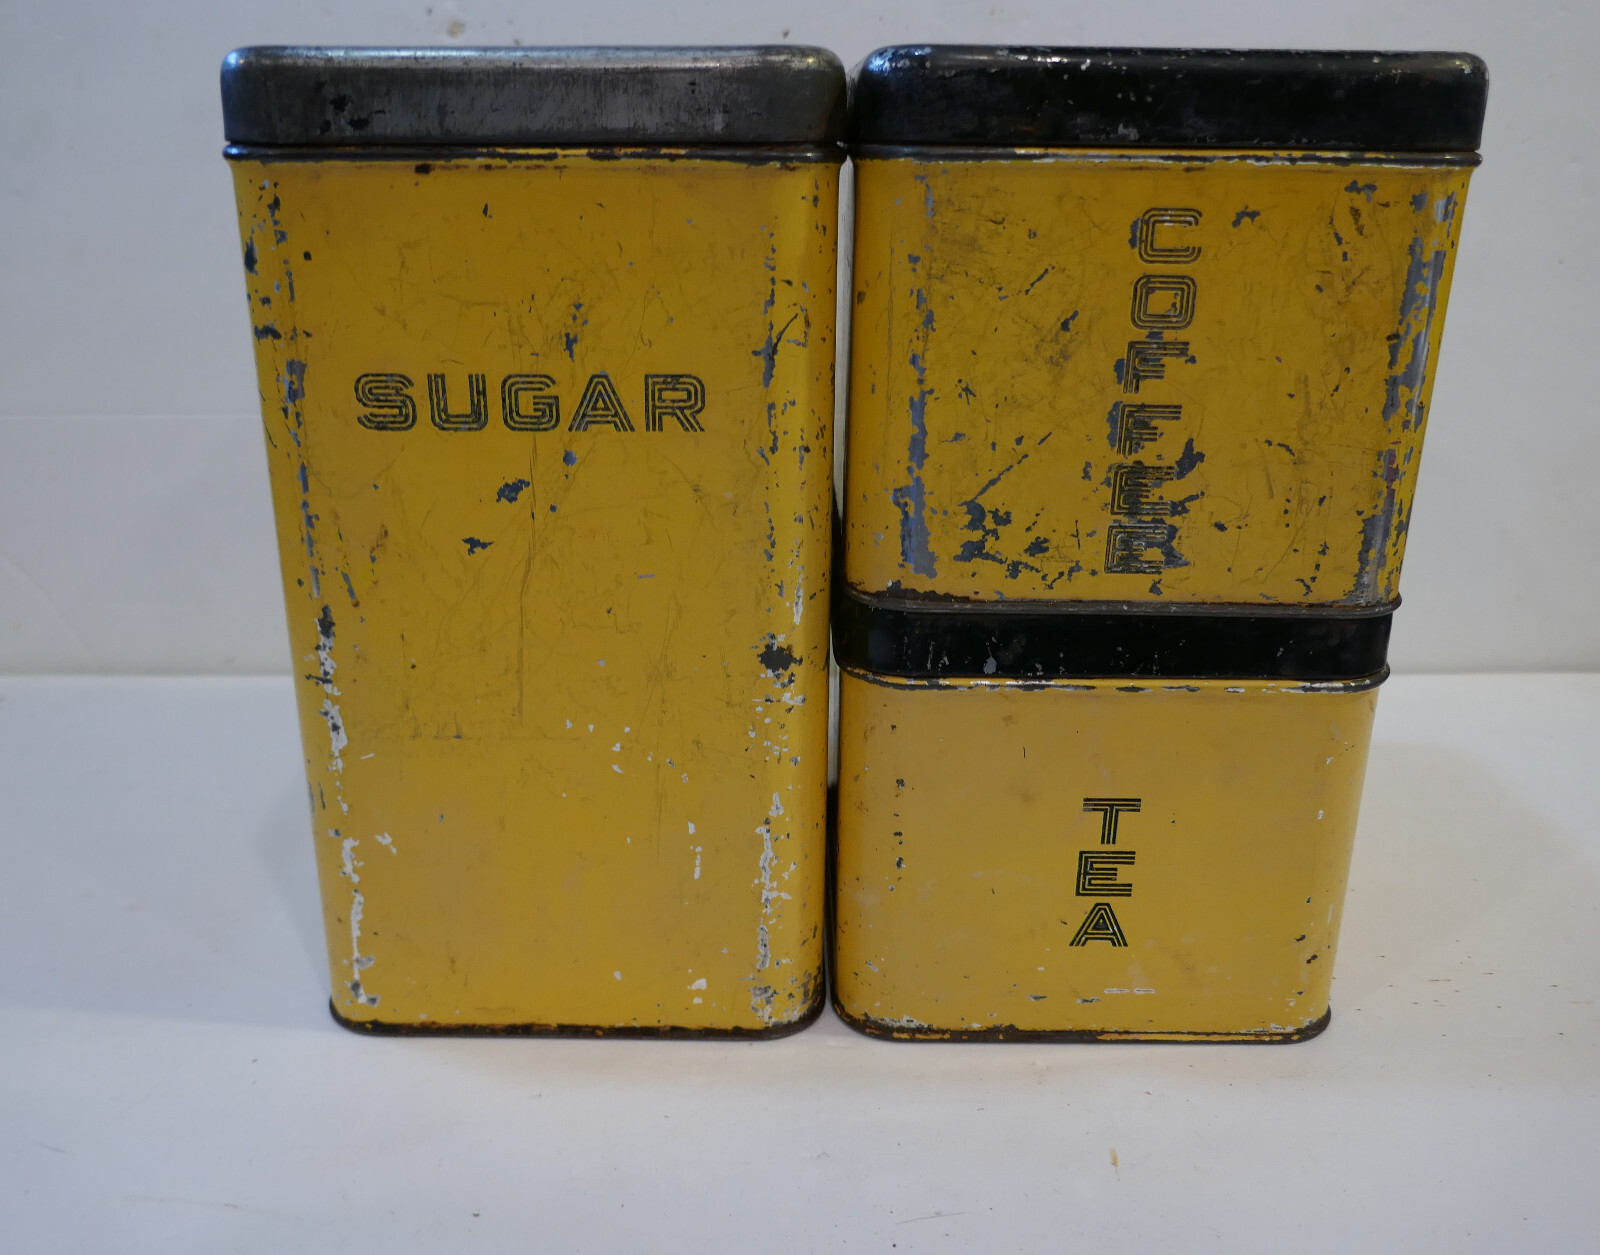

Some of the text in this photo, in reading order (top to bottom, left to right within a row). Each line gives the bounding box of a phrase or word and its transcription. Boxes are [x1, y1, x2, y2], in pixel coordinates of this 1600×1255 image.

[354, 373, 706, 432] SUGAR
[1104, 207, 1203, 575] COFFEE
[1069, 797, 1142, 947] TEA
